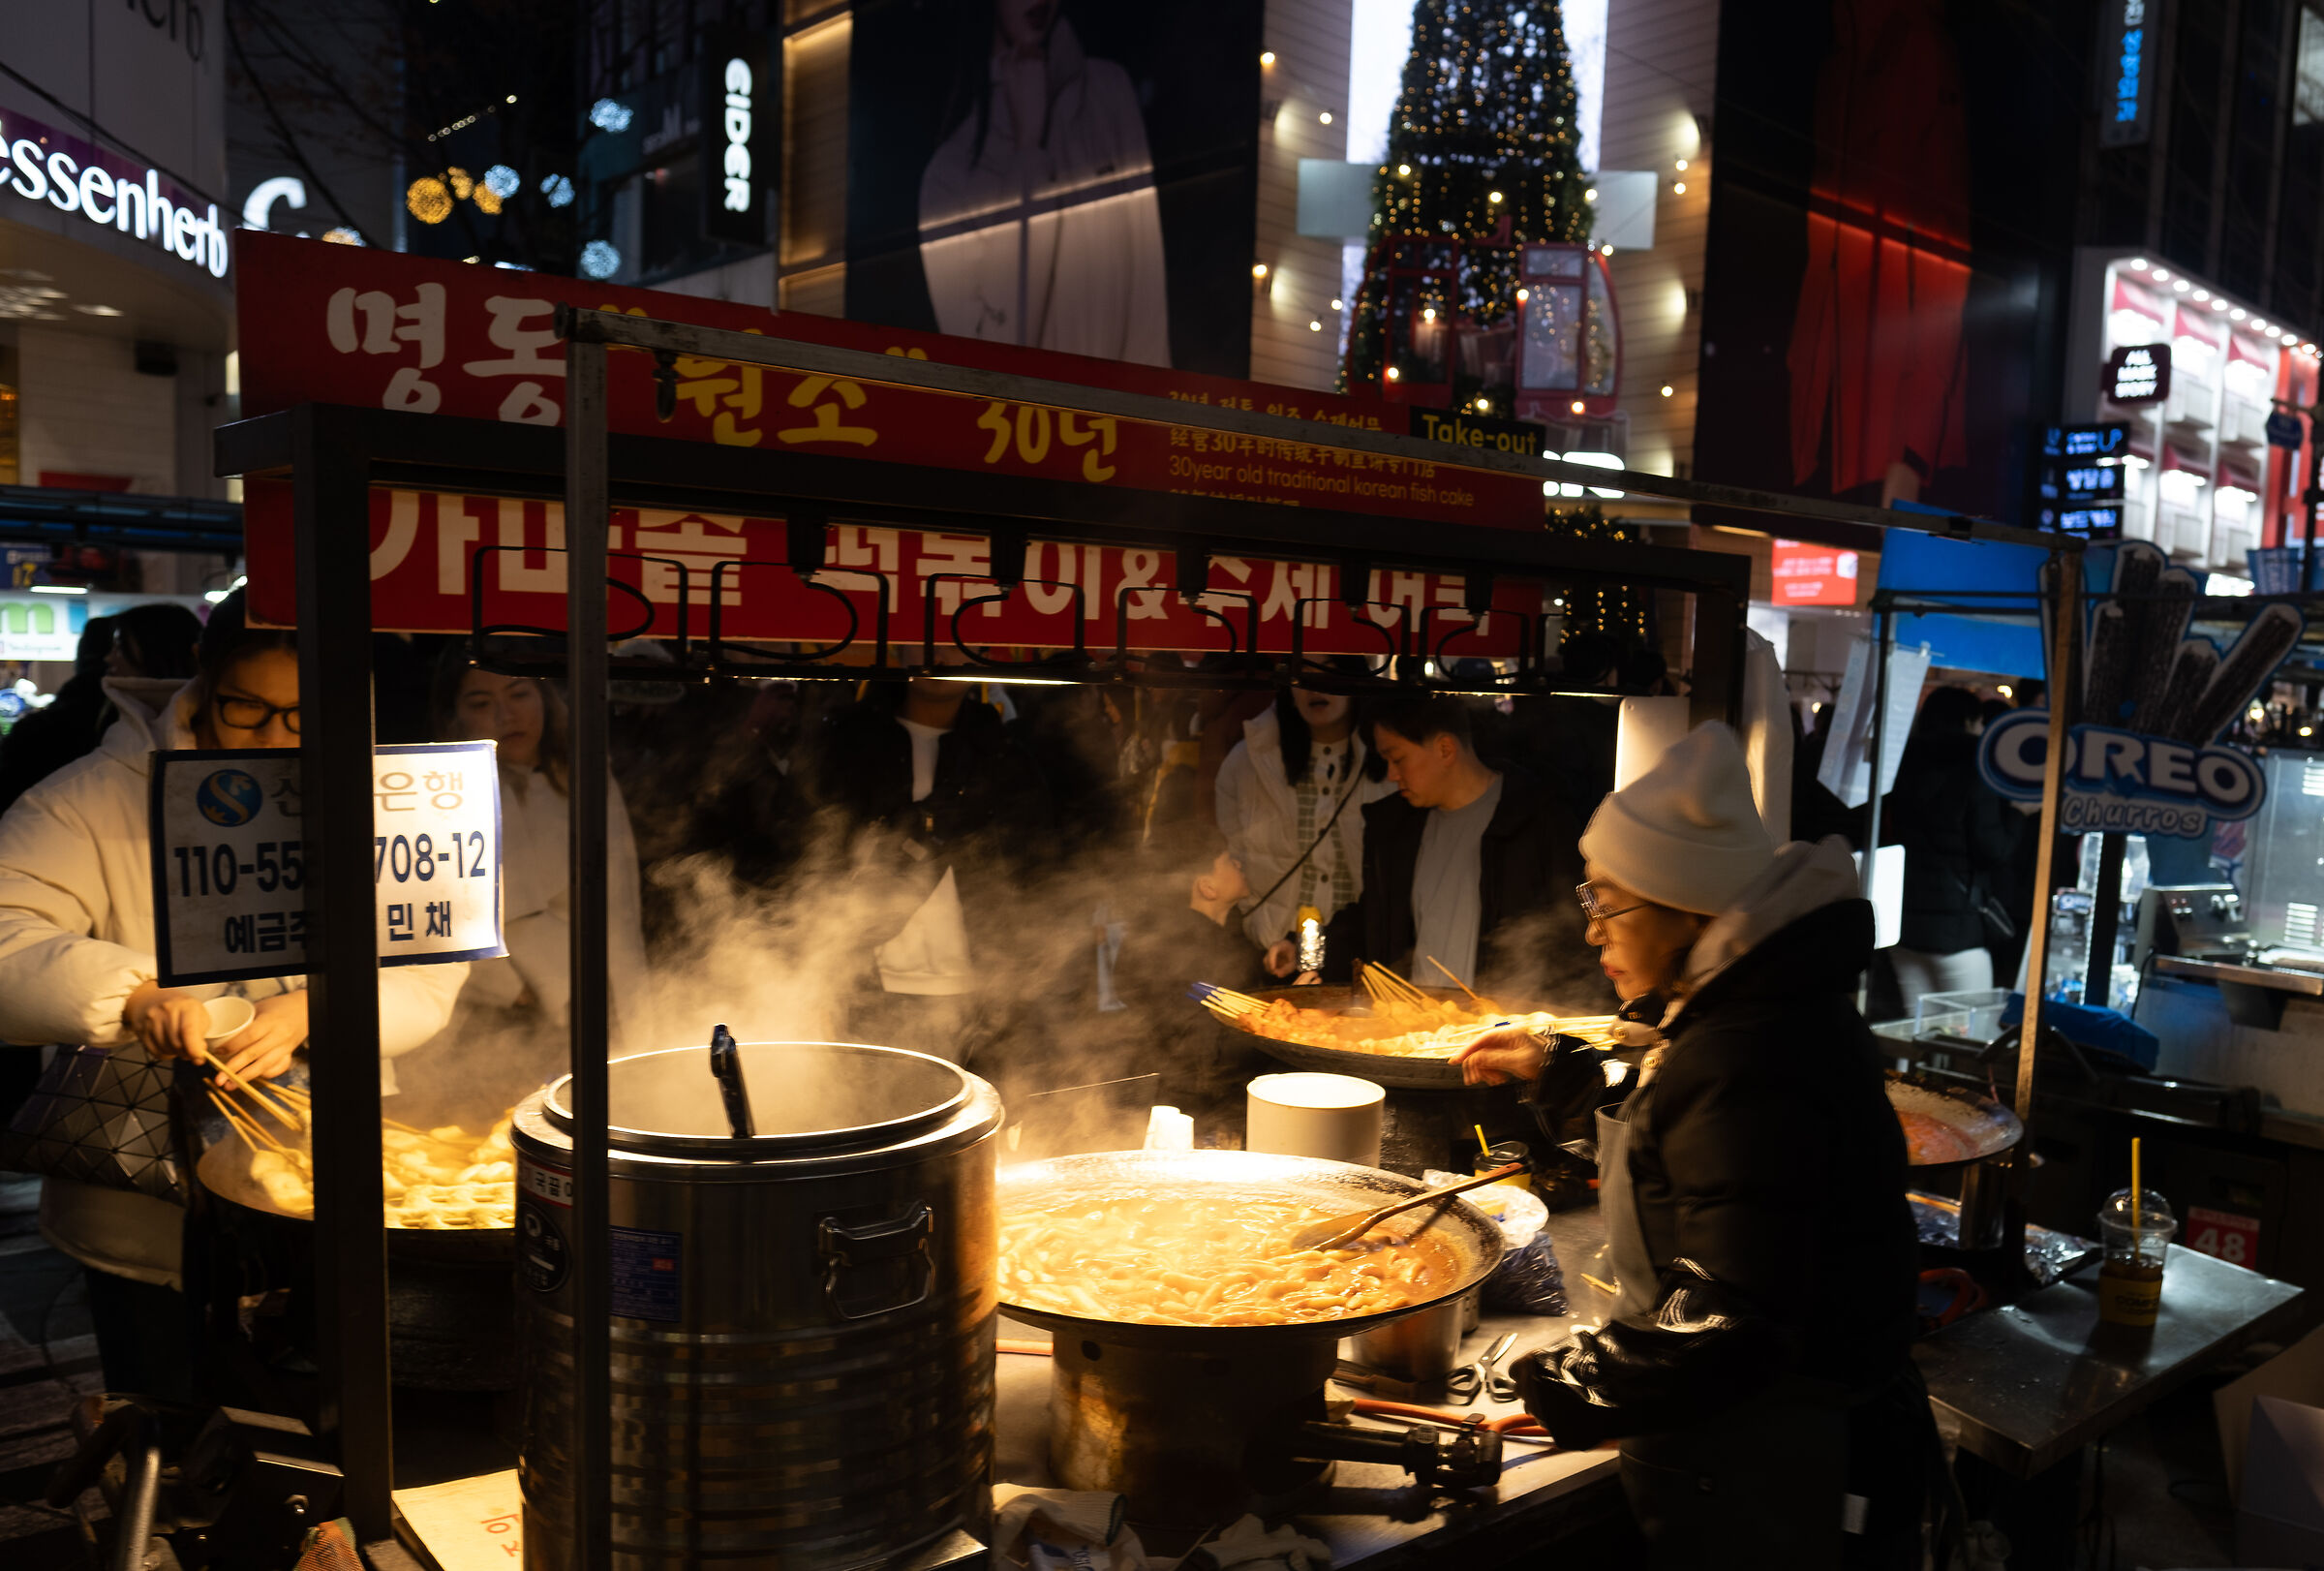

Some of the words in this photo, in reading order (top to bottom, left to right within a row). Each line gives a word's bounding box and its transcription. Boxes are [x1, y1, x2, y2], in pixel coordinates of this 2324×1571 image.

[724, 57, 752, 212] CIDER
[326, 283, 567, 426] 명동
[1422, 414, 1538, 456] Take-out
[1170, 455, 1233, 482] 30year
[1237, 464, 1263, 484] old
[1267, 467, 1350, 494] traditional
[1354, 477, 1406, 500] korean
[1411, 482, 1437, 504] fish
[1439, 487, 1475, 508] cake
[1994, 722, 2250, 804] OREO
[2064, 795, 2203, 832] Churros
[2194, 1227, 2247, 1264] 48
